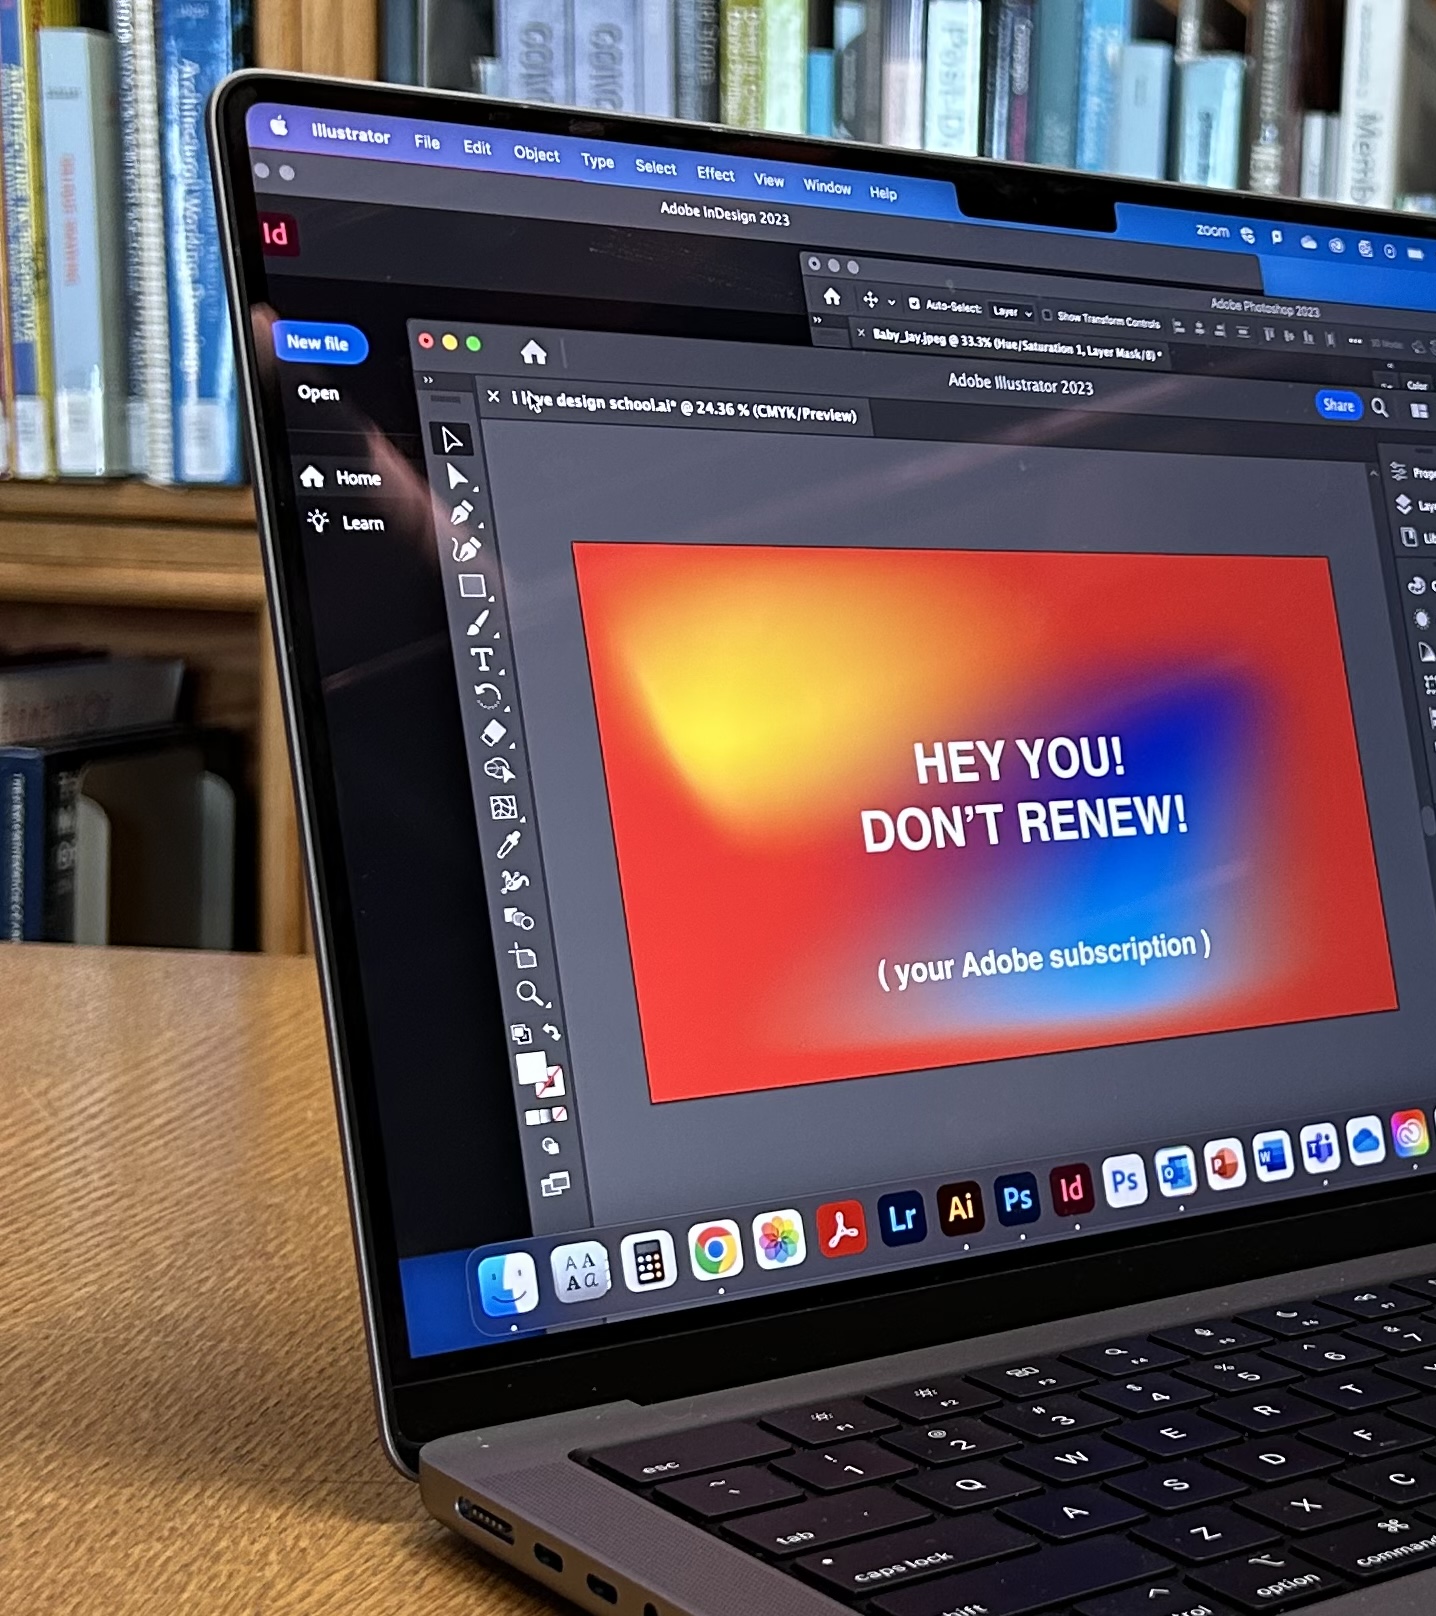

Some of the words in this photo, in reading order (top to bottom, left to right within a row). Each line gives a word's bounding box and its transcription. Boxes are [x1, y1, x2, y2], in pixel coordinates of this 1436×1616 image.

[312, 122, 391, 145] Illustrator
[415, 133, 441, 151] File
[464, 138, 492, 157] Edit
[514, 144, 561, 164] Object
[581, 152, 615, 172] Type
[635, 158, 678, 177] Select
[697, 165, 736, 183] Effect
[754, 172, 785, 189] View
[803, 177, 852, 197] Window
[870, 184, 898, 202] Help
[660, 201, 702, 219] Adobe
[703, 205, 757, 226] InDesign
[759, 210, 791, 227] 2023
[262, 222, 289, 247] Id
[1195, 224, 1231, 239] zoom
[993, 306, 1018, 319] Layer
[1211, 297, 1242, 311] Adobe
[1243, 300, 1294, 319] Photoshop
[286, 333, 322, 352] New
[323, 335, 349, 353] file
[949, 335, 959, 348] @
[960, 335, 993, 348] 33.3%
[1086, 345, 1114, 359] Layer
[948, 371, 993, 391] Adobe
[994, 373, 1058, 394] Illustrator
[1060, 379, 1095, 396] 2023
[1406, 380, 1429, 392] Color
[297, 384, 340, 406] Open
[520, 390, 555, 407] lve
[556, 393, 606, 411] design
[680, 401, 694, 417] @
[696, 401, 736, 418] 24.36
[737, 403, 750, 418] %
[752, 404, 858, 426] (CMYK/Preview)
[1322, 397, 1357, 414] Share
[336, 469, 383, 487] Home
[343, 514, 385, 533] Learn
[913, 739, 1006, 785] HEY
[1014, 735, 1126, 780] YOU!
[860, 803, 1004, 854] DON’T
[1016, 794, 1189, 844] RENEW!
[893, 955, 956, 992] your
[962, 947, 1044, 979] Adobe
[1049, 931, 1198, 970] subscription
[1258, 1150, 1272, 1164] W
[1060, 1174, 1085, 1203] Id
[1112, 1169, 1139, 1194] Ps
[947, 1194, 976, 1223] Ai
[1003, 1187, 1033, 1216] Ps
[888, 1203, 917, 1234] Lr
[1403, 1332, 1422, 1342] 7
[1324, 1351, 1346, 1361] 6
[1237, 1371, 1261, 1381] 5
[1339, 1383, 1363, 1394] T
[1151, 1392, 1171, 1402] 4
[1252, 1405, 1281, 1416] R
[1051, 1415, 1076, 1426] 3
[1159, 1427, 1187, 1439] E
[1353, 1429, 1373, 1441] F
[949, 1439, 976, 1451] 2
[1054, 1450, 1089, 1465] W
[1258, 1453, 1286, 1465] D
[642, 1461, 680, 1474] esc
[843, 1465, 864, 1475] 1
[955, 1479, 987, 1491] Q
[1163, 1478, 1190, 1491] S
[1388, 1473, 1416, 1485] C
[1290, 1497, 1322, 1512] X
[1062, 1506, 1090, 1519] A
[776, 1532, 815, 1545] tab
[1189, 1526, 1222, 1541] Z
[854, 1560, 906, 1582] caps
[905, 1552, 954, 1570] lock
[1256, 1574, 1321, 1597] option
